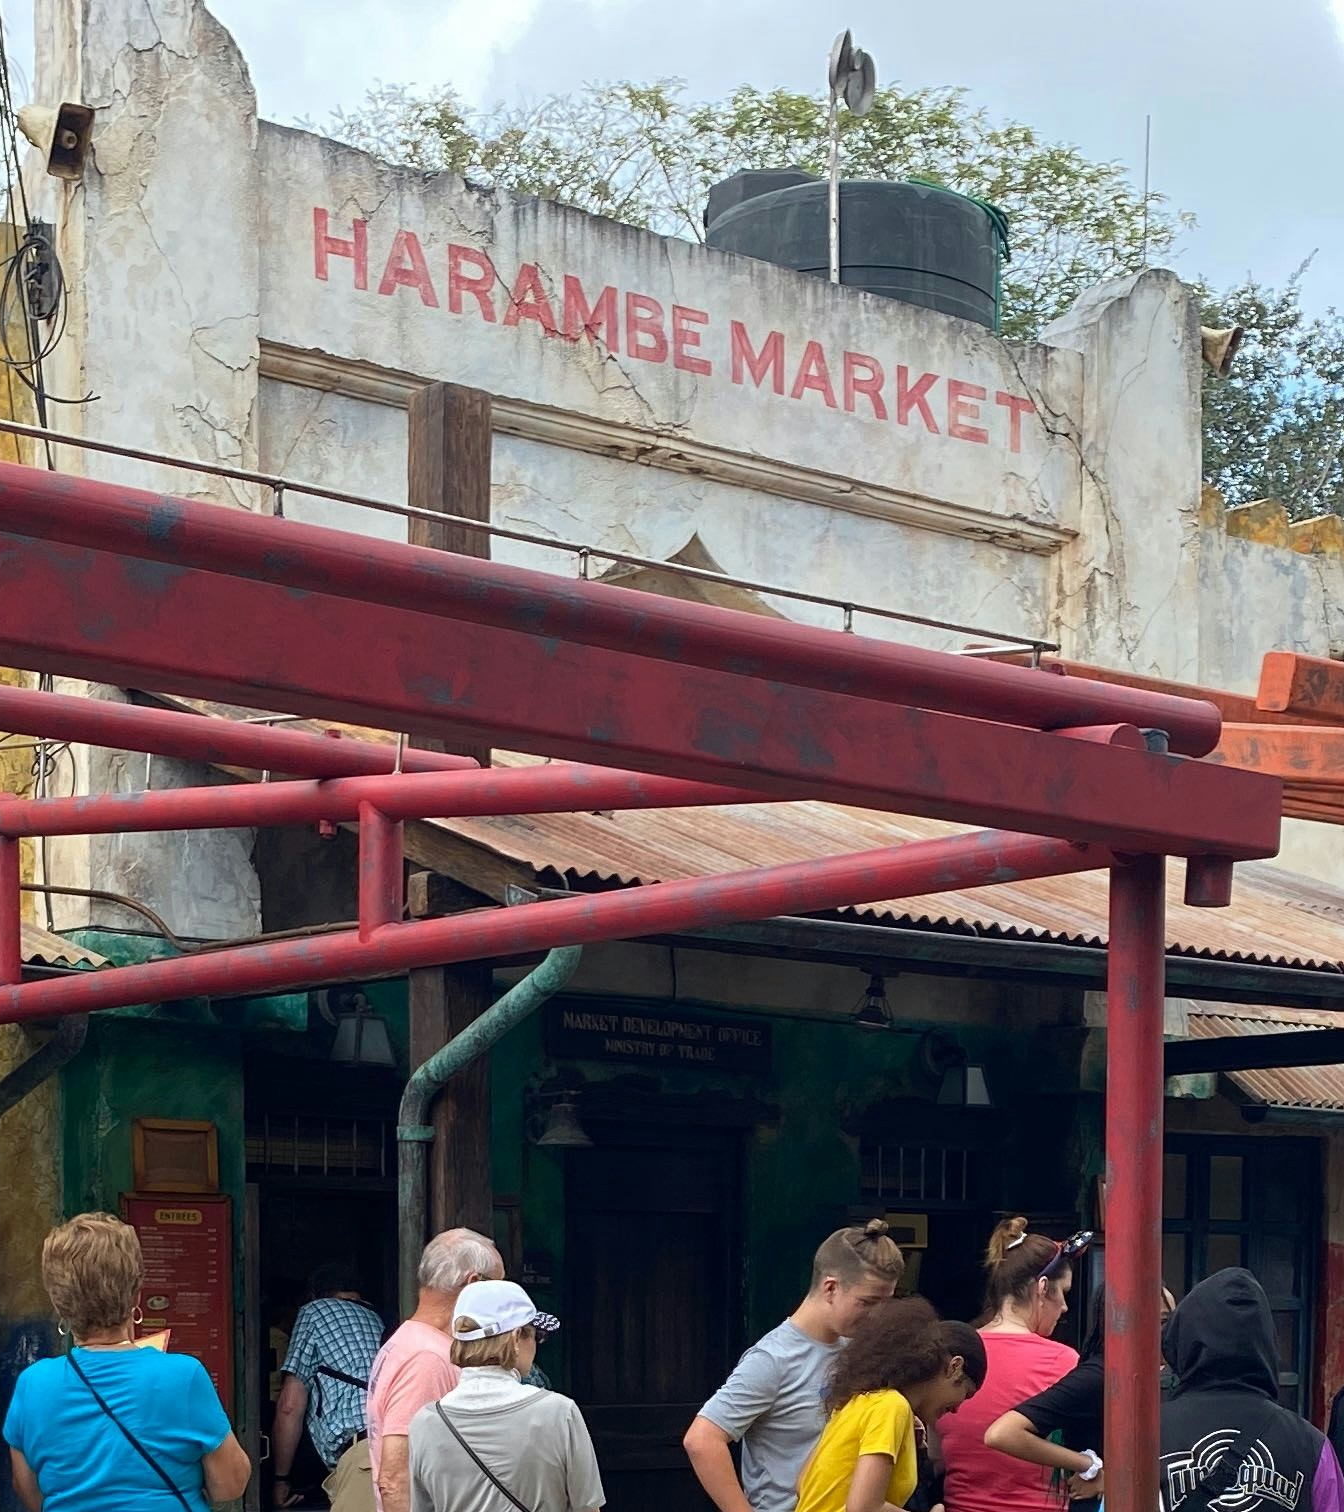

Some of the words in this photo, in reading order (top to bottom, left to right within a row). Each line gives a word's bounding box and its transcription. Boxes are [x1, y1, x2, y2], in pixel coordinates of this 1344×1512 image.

[313, 206, 713, 377] HARAMBE
[730, 319, 1036, 454] MARKET
[563, 1011, 618, 1032] MARKET
[623, 1016, 712, 1040] DEVELOPMENT
[718, 1024, 762, 1046] OFFICE
[605, 1039, 655, 1057] MINISTRY
